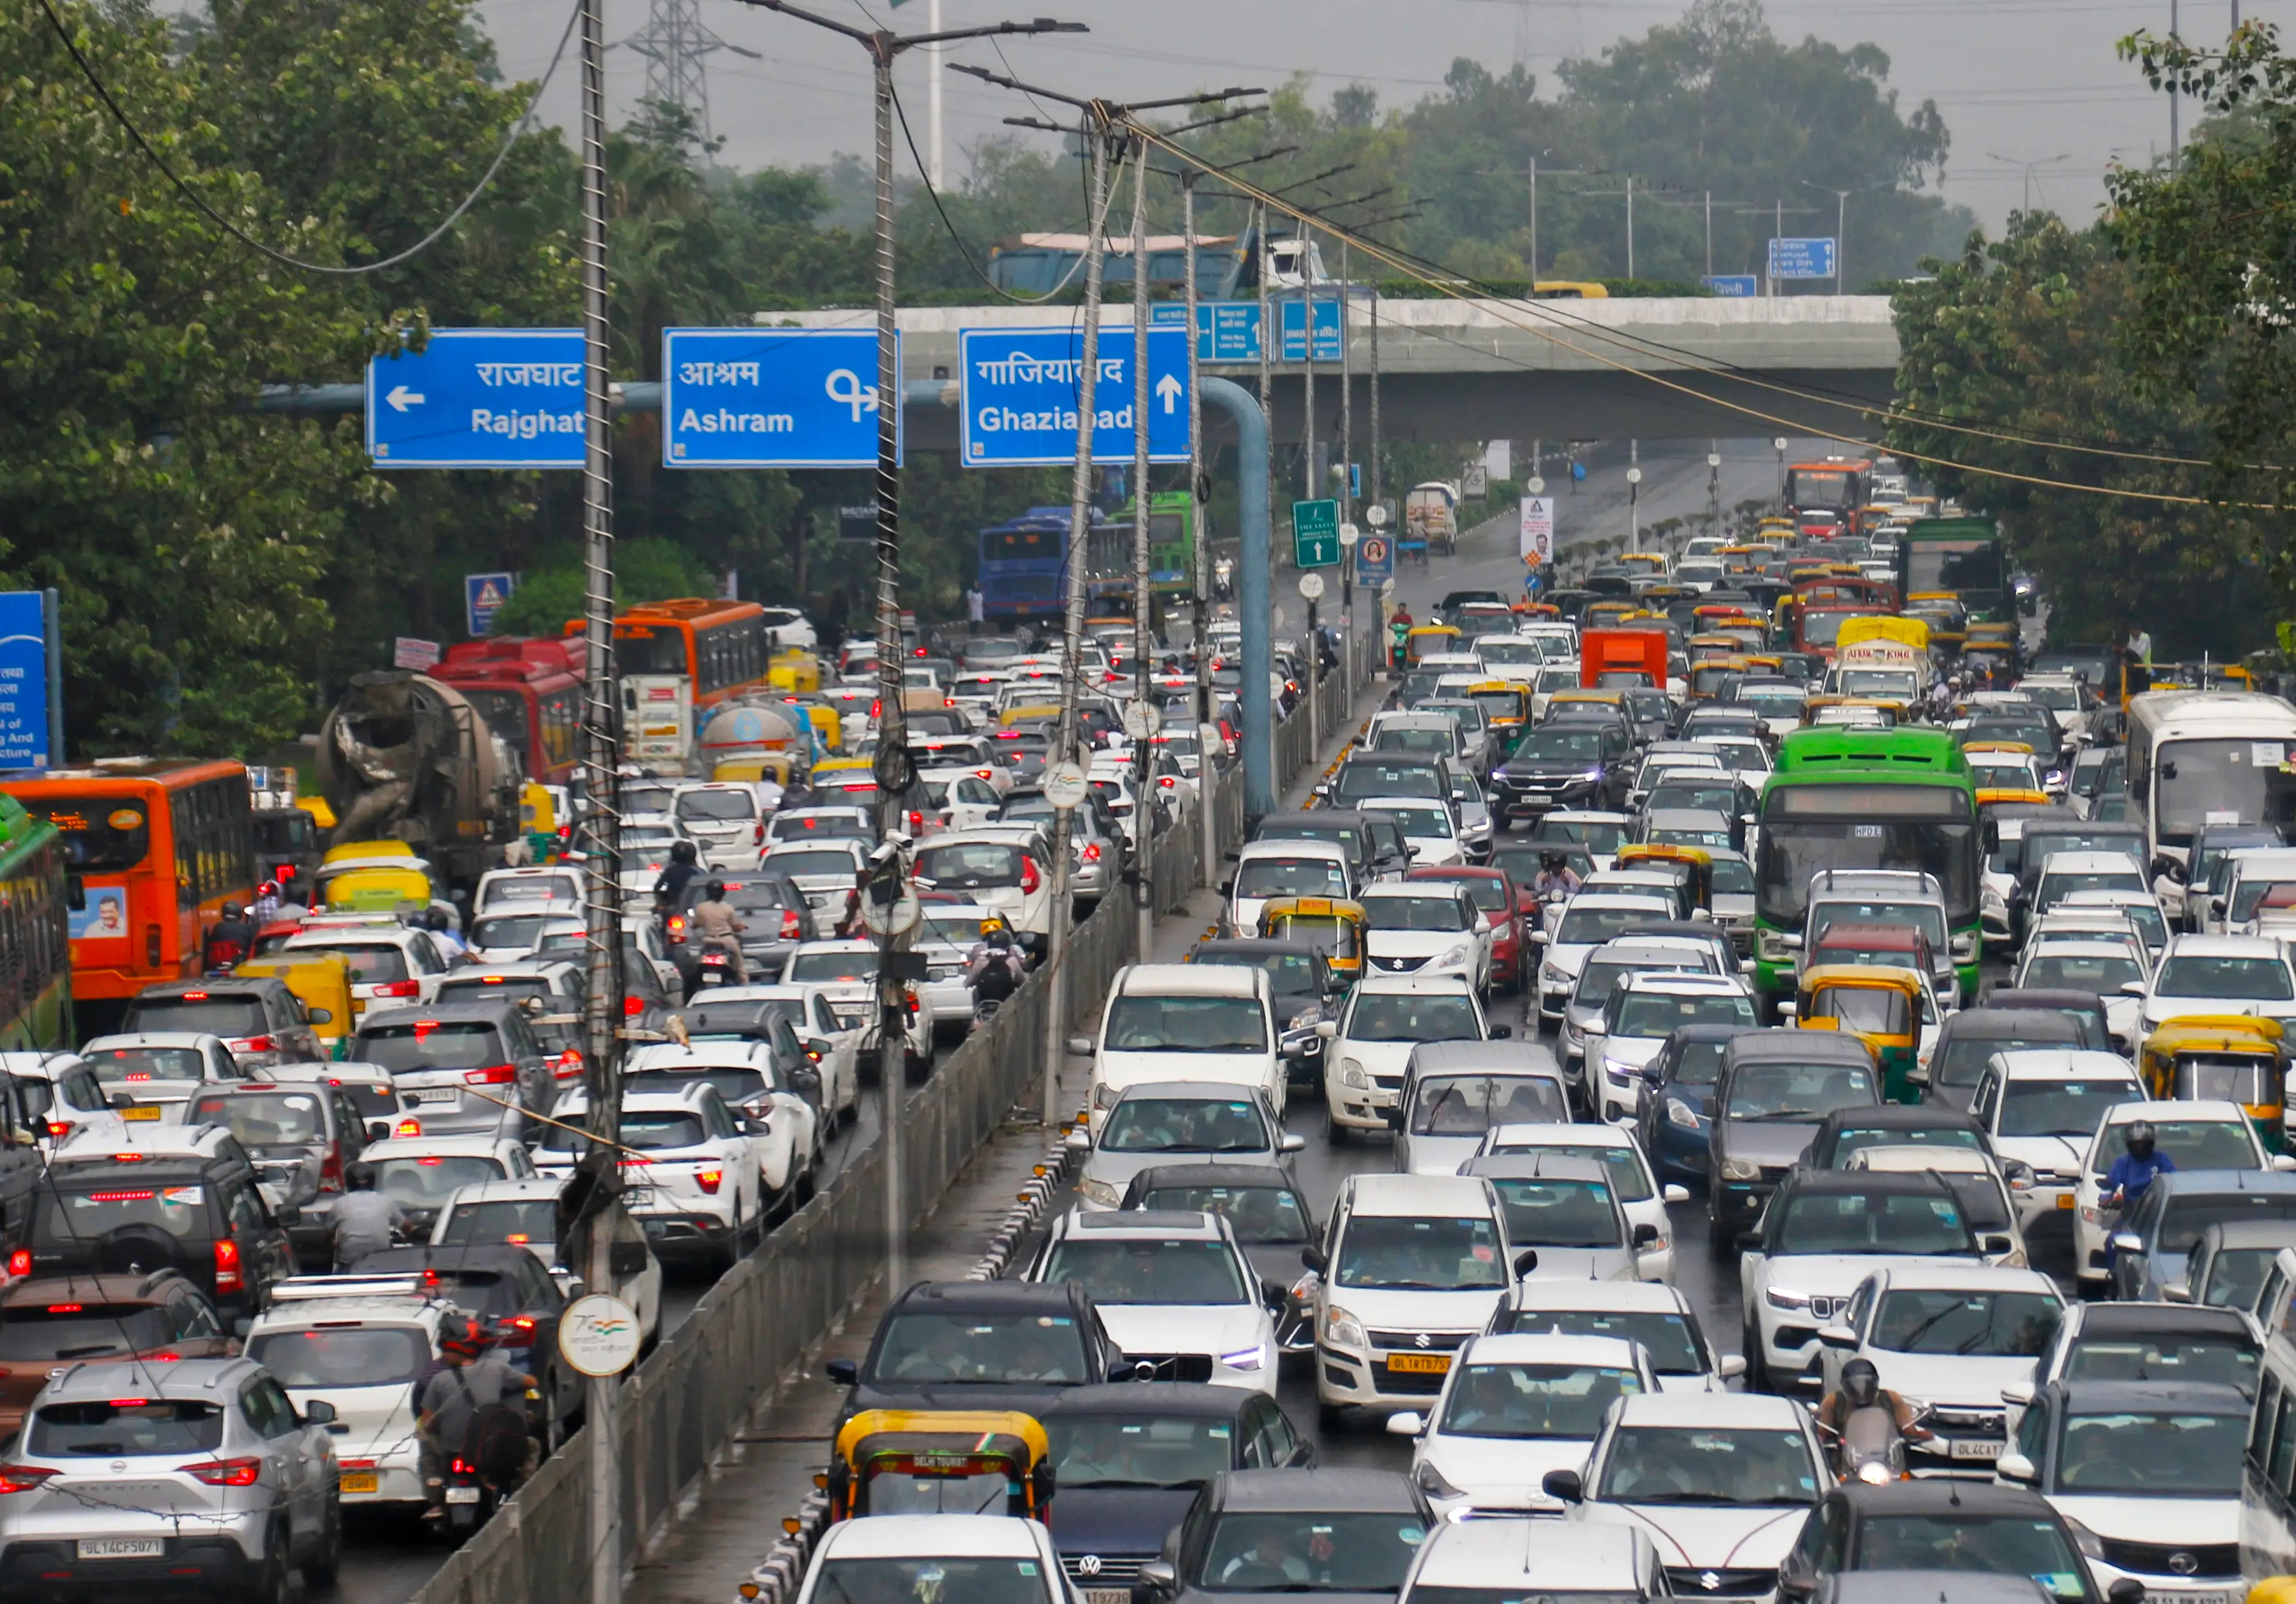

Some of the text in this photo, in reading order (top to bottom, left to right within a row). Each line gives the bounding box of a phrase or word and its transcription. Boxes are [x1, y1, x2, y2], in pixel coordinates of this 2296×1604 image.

[474, 362, 583, 387] राजघाट
[678, 362, 761, 386] आश्रम
[472, 408, 586, 439] Rajghat
[678, 408, 794, 432] Ashram
[978, 404, 1133, 432] Ghaziaad
[7, 718, 21, 729] of
[8, 732, 33, 743] And
[86, 1540, 160, 1554] DL14CF5071
